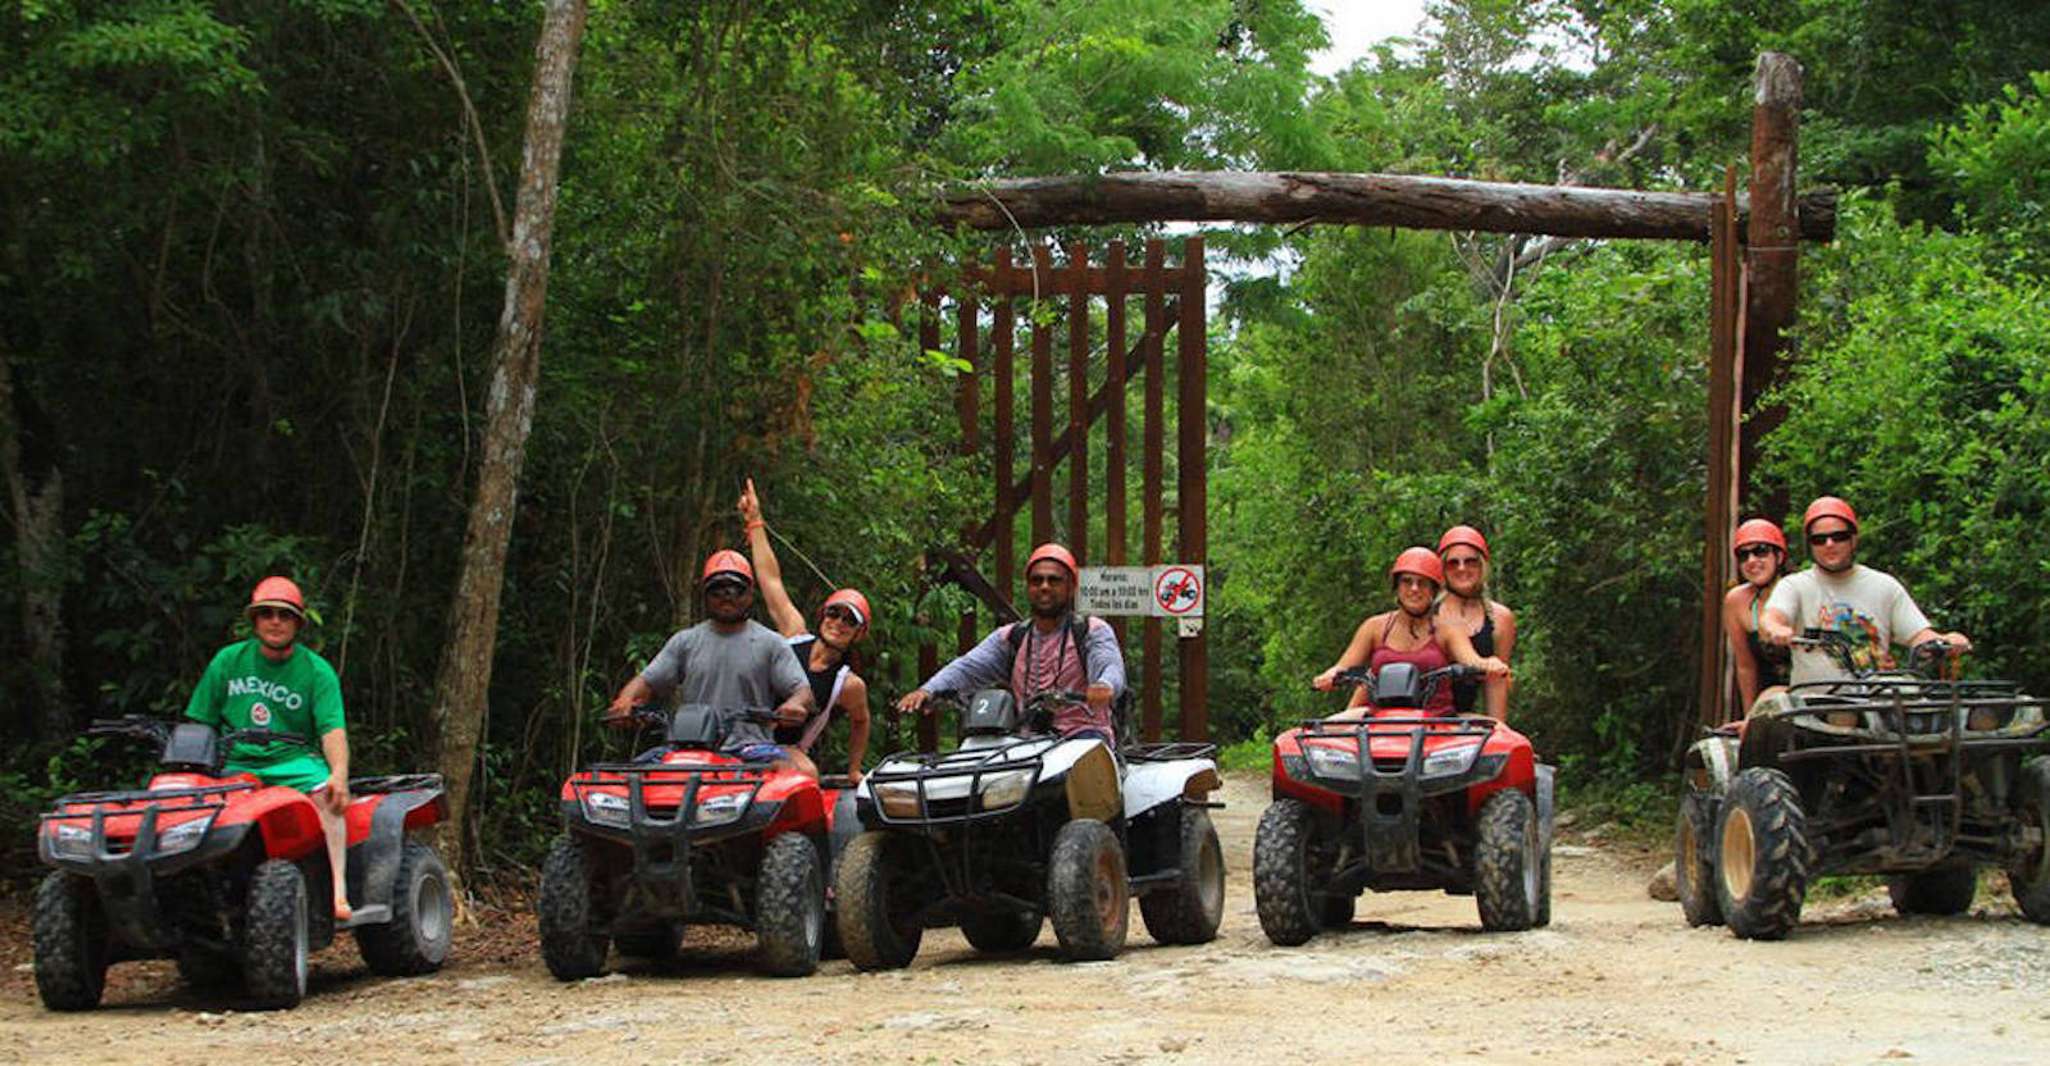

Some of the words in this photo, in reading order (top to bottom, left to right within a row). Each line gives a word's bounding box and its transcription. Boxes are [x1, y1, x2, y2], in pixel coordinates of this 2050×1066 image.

[1090, 599, 1110, 609] Todos
[228, 676, 302, 710] MEXICO
[977, 698, 989, 714] 2
